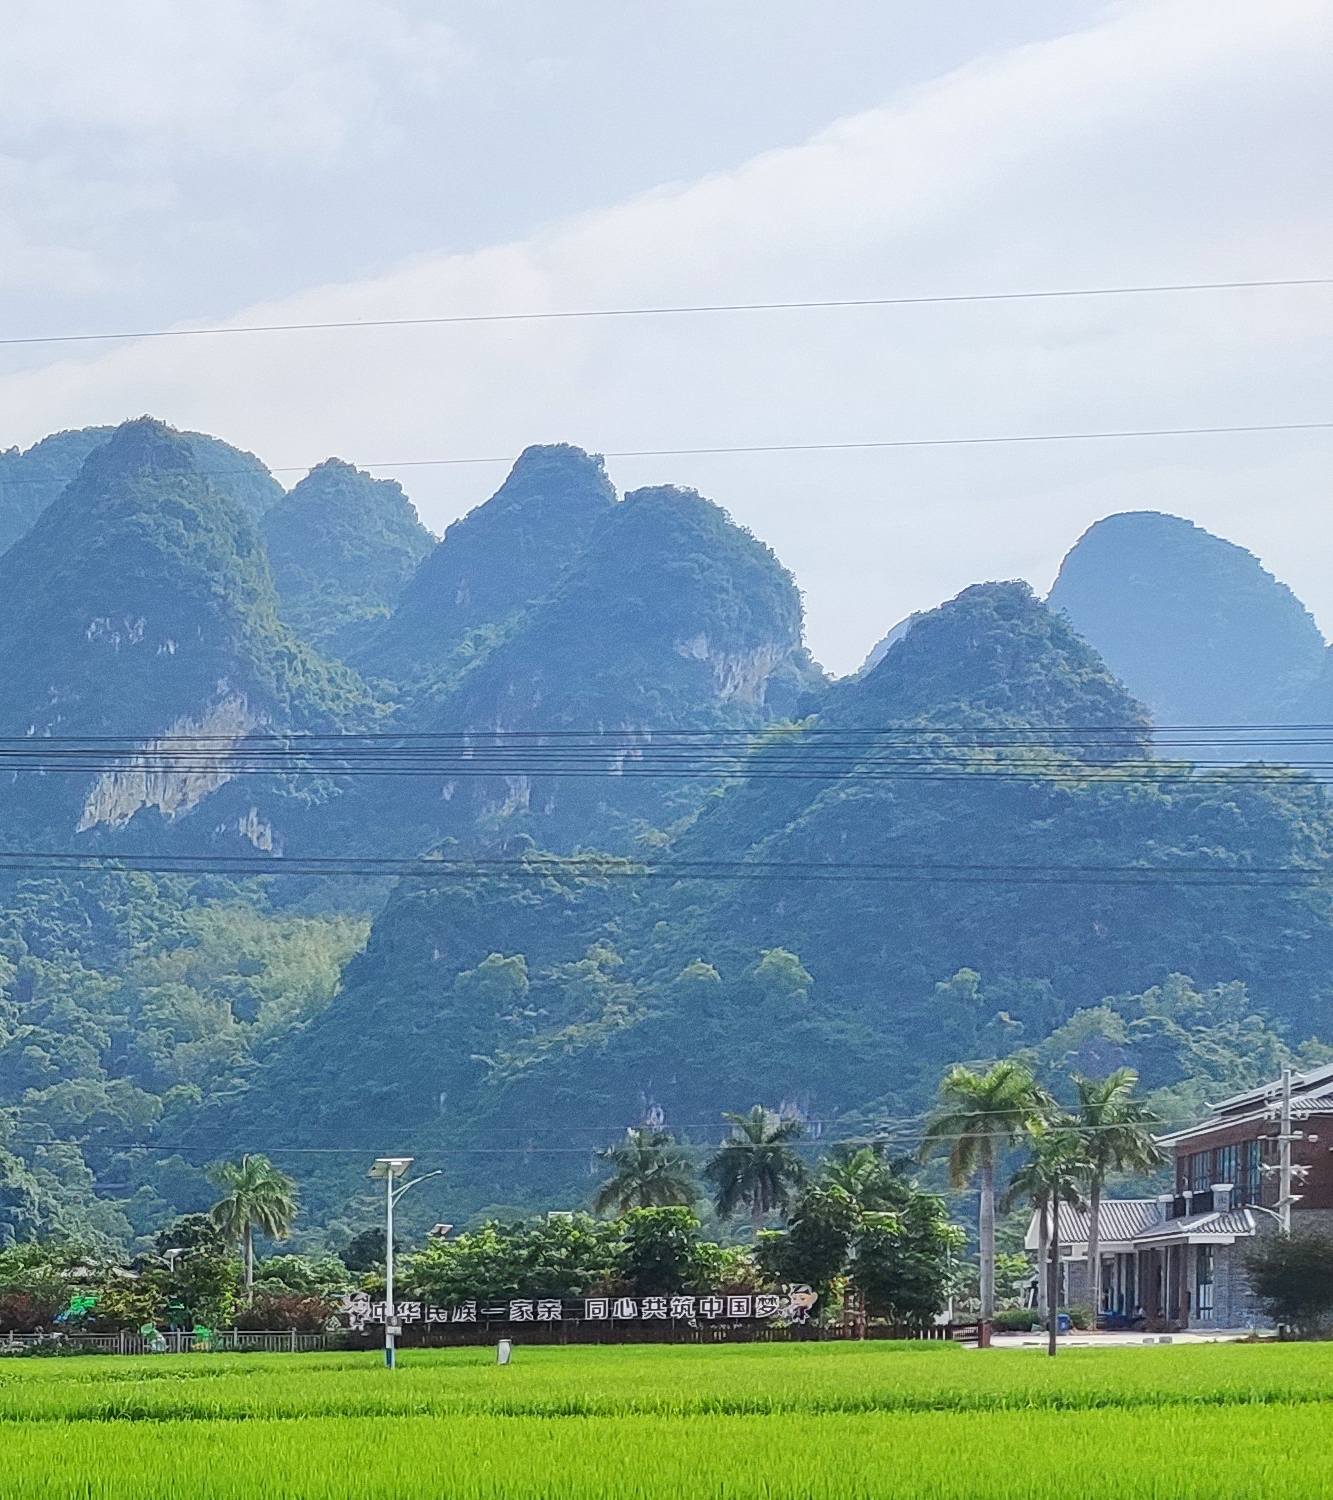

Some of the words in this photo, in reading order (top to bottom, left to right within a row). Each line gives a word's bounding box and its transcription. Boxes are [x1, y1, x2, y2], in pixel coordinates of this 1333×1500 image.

[372, 1299, 562, 1323] 中华民族一家亲
[585, 1295, 780, 1319] 同心共筑中国梦
